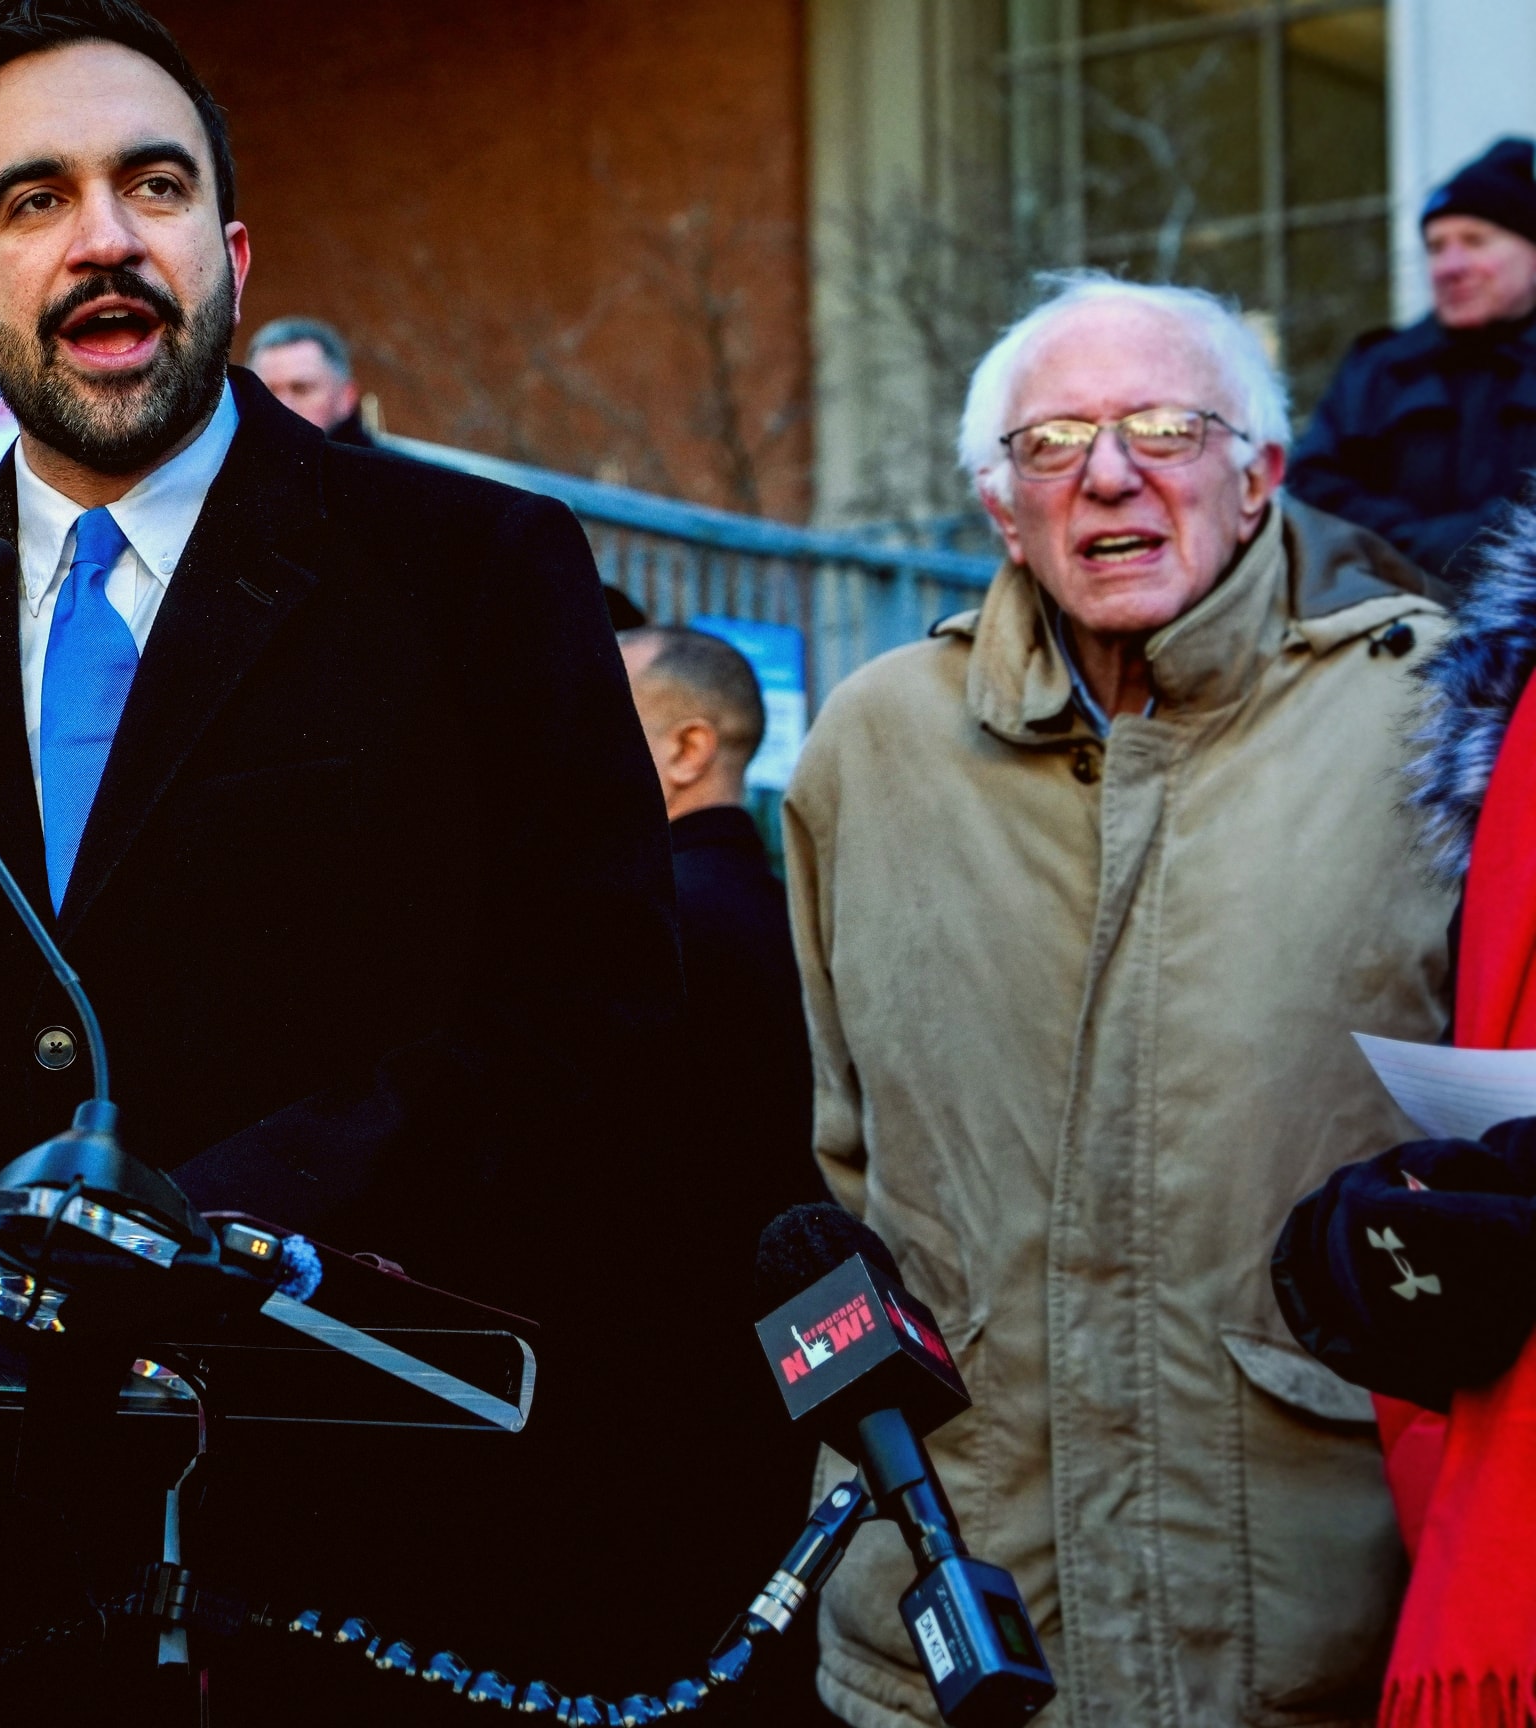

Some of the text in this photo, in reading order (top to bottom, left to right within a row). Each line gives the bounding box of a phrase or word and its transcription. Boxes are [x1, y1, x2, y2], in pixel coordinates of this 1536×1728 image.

[803, 1293, 867, 1343] DEMOCRACY
[920, 1613, 936, 1638] DN
[930, 1638, 946, 1664] KIT
